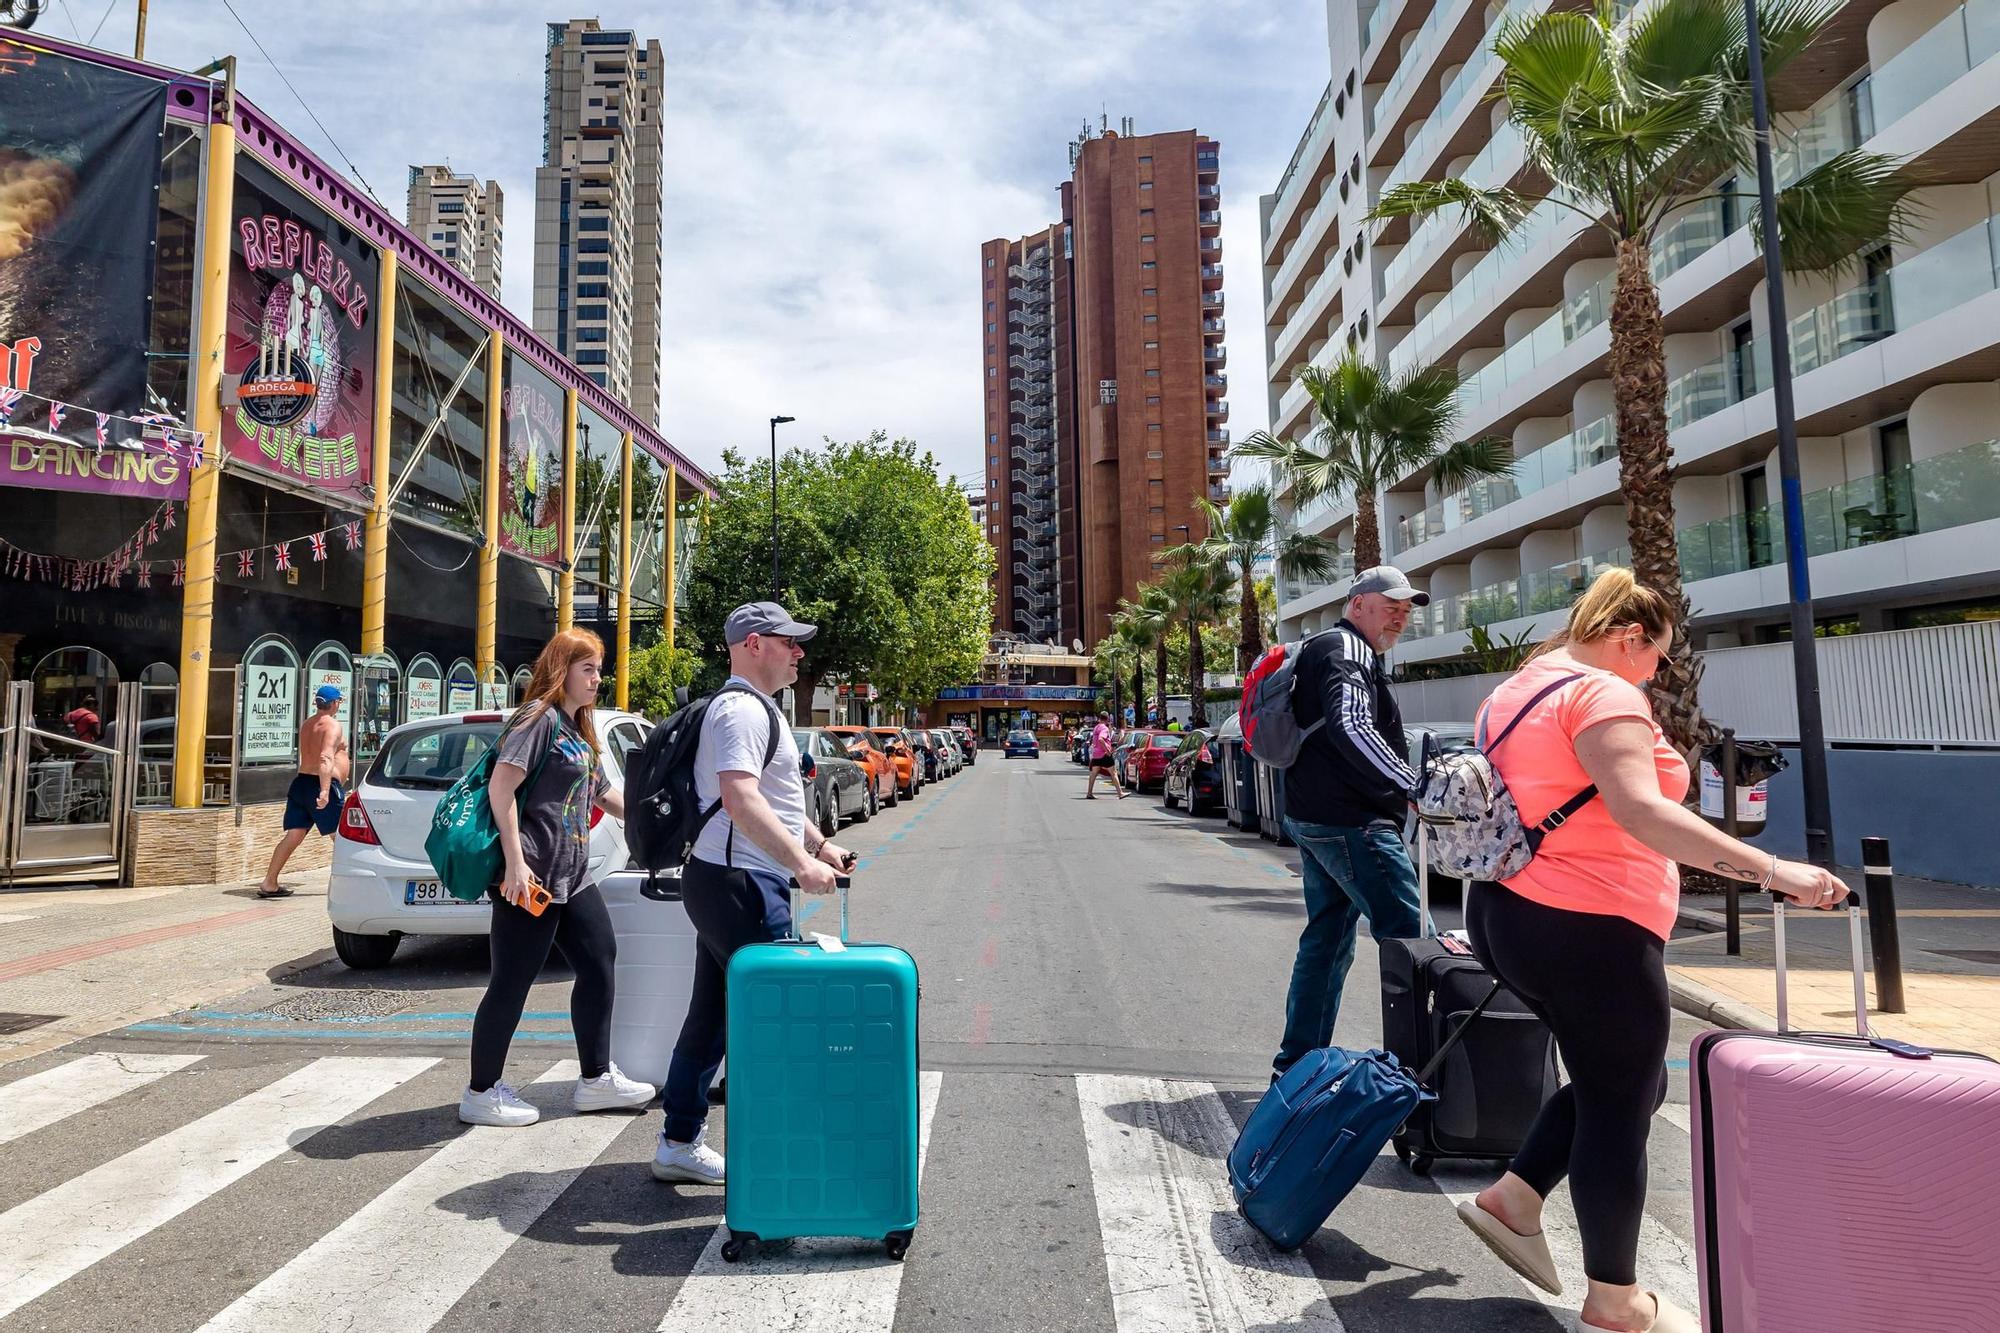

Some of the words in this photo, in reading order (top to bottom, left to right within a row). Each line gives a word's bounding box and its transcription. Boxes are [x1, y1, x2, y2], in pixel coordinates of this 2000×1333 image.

[249, 381, 297, 393] BODEGA
[10, 439, 180, 485] DANCING
[257, 671, 287, 699] 2x1
[252, 703, 267, 714] ALL
[268, 703, 291, 715] NIGHT
[248, 732, 268, 741] LAGER
[268, 732, 279, 740] TILL
[247, 741, 270, 749] EVERYONE
